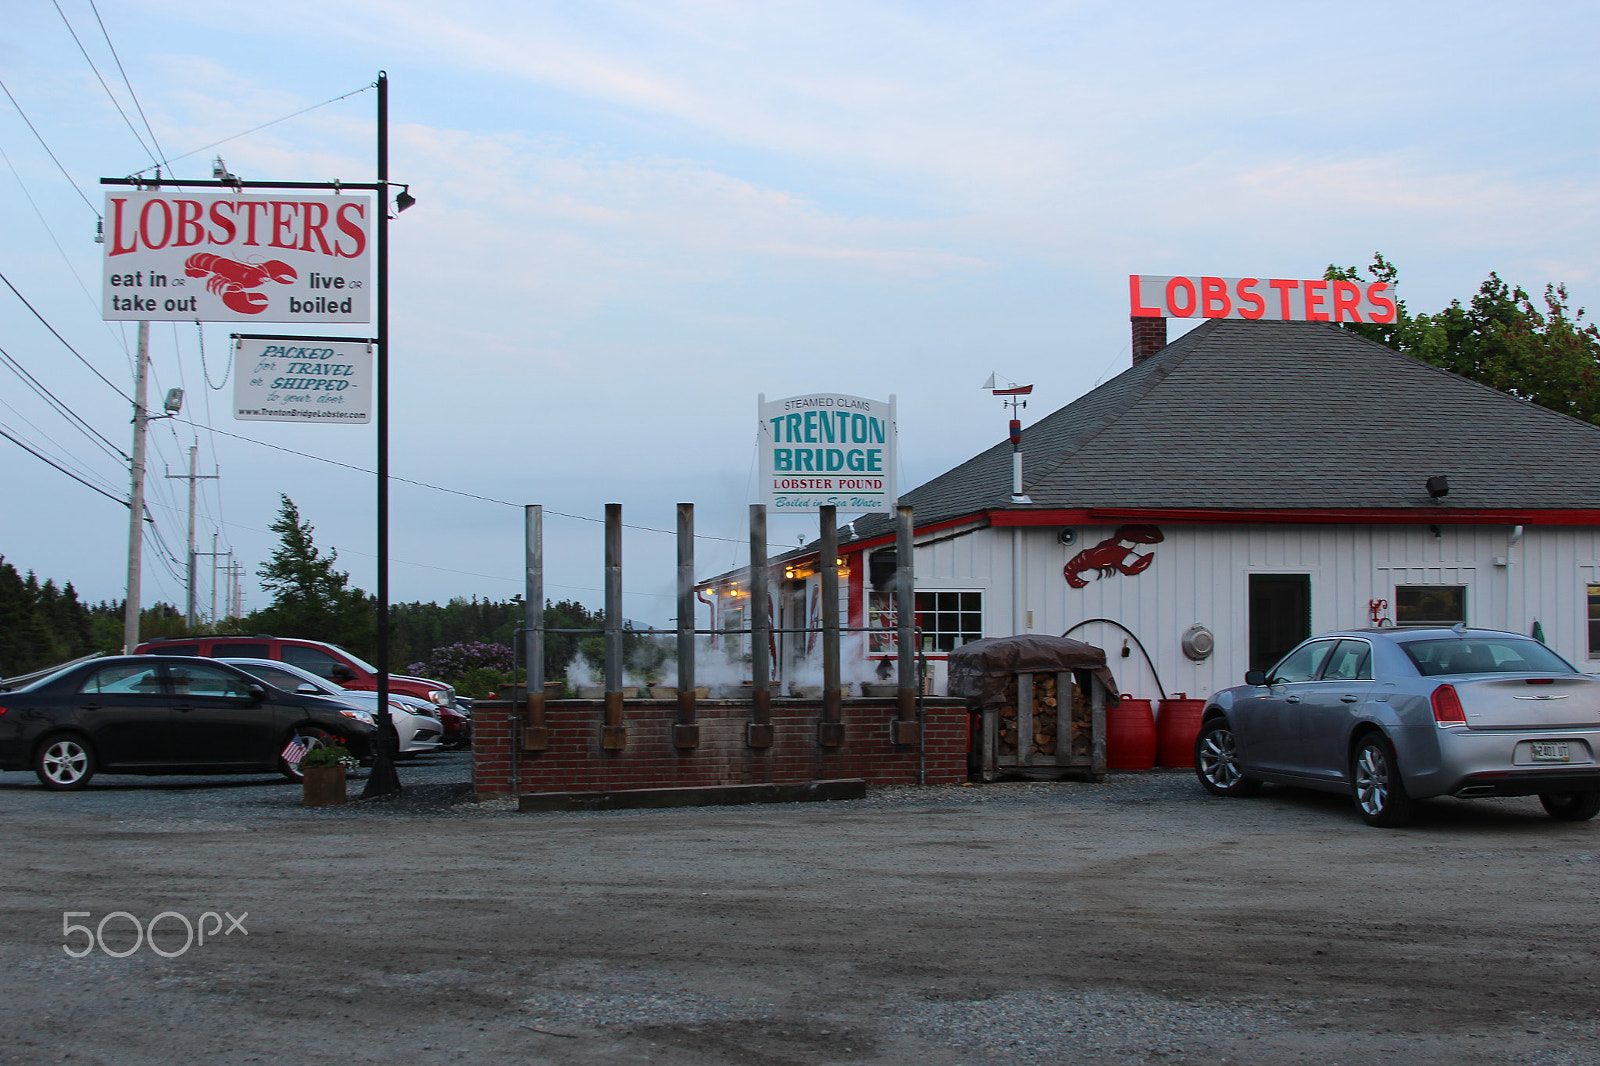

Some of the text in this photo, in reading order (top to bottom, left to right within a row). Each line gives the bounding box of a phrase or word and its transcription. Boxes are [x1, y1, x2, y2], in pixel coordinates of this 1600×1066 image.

[109, 198, 366, 259] LOBSTERS
[110, 271, 142, 287] eat
[150, 271, 167, 287] in
[309, 272, 345, 289] live
[112, 295, 197, 312] take out
[289, 297, 352, 314] boiled
[1129, 274, 1395, 324] LOBSTERS
[285, 362, 355, 376] TRAVEL
[785, 398, 870, 411] STEAMED CLAMS
[770, 410, 885, 443] TRENTON
[774, 448, 882, 471] BRIDGE
[774, 479, 882, 489] LOBSTER POUND
[775, 496, 811, 507] Boiled
[825, 496, 847, 507] Sea
[850, 497, 882, 507] Water
